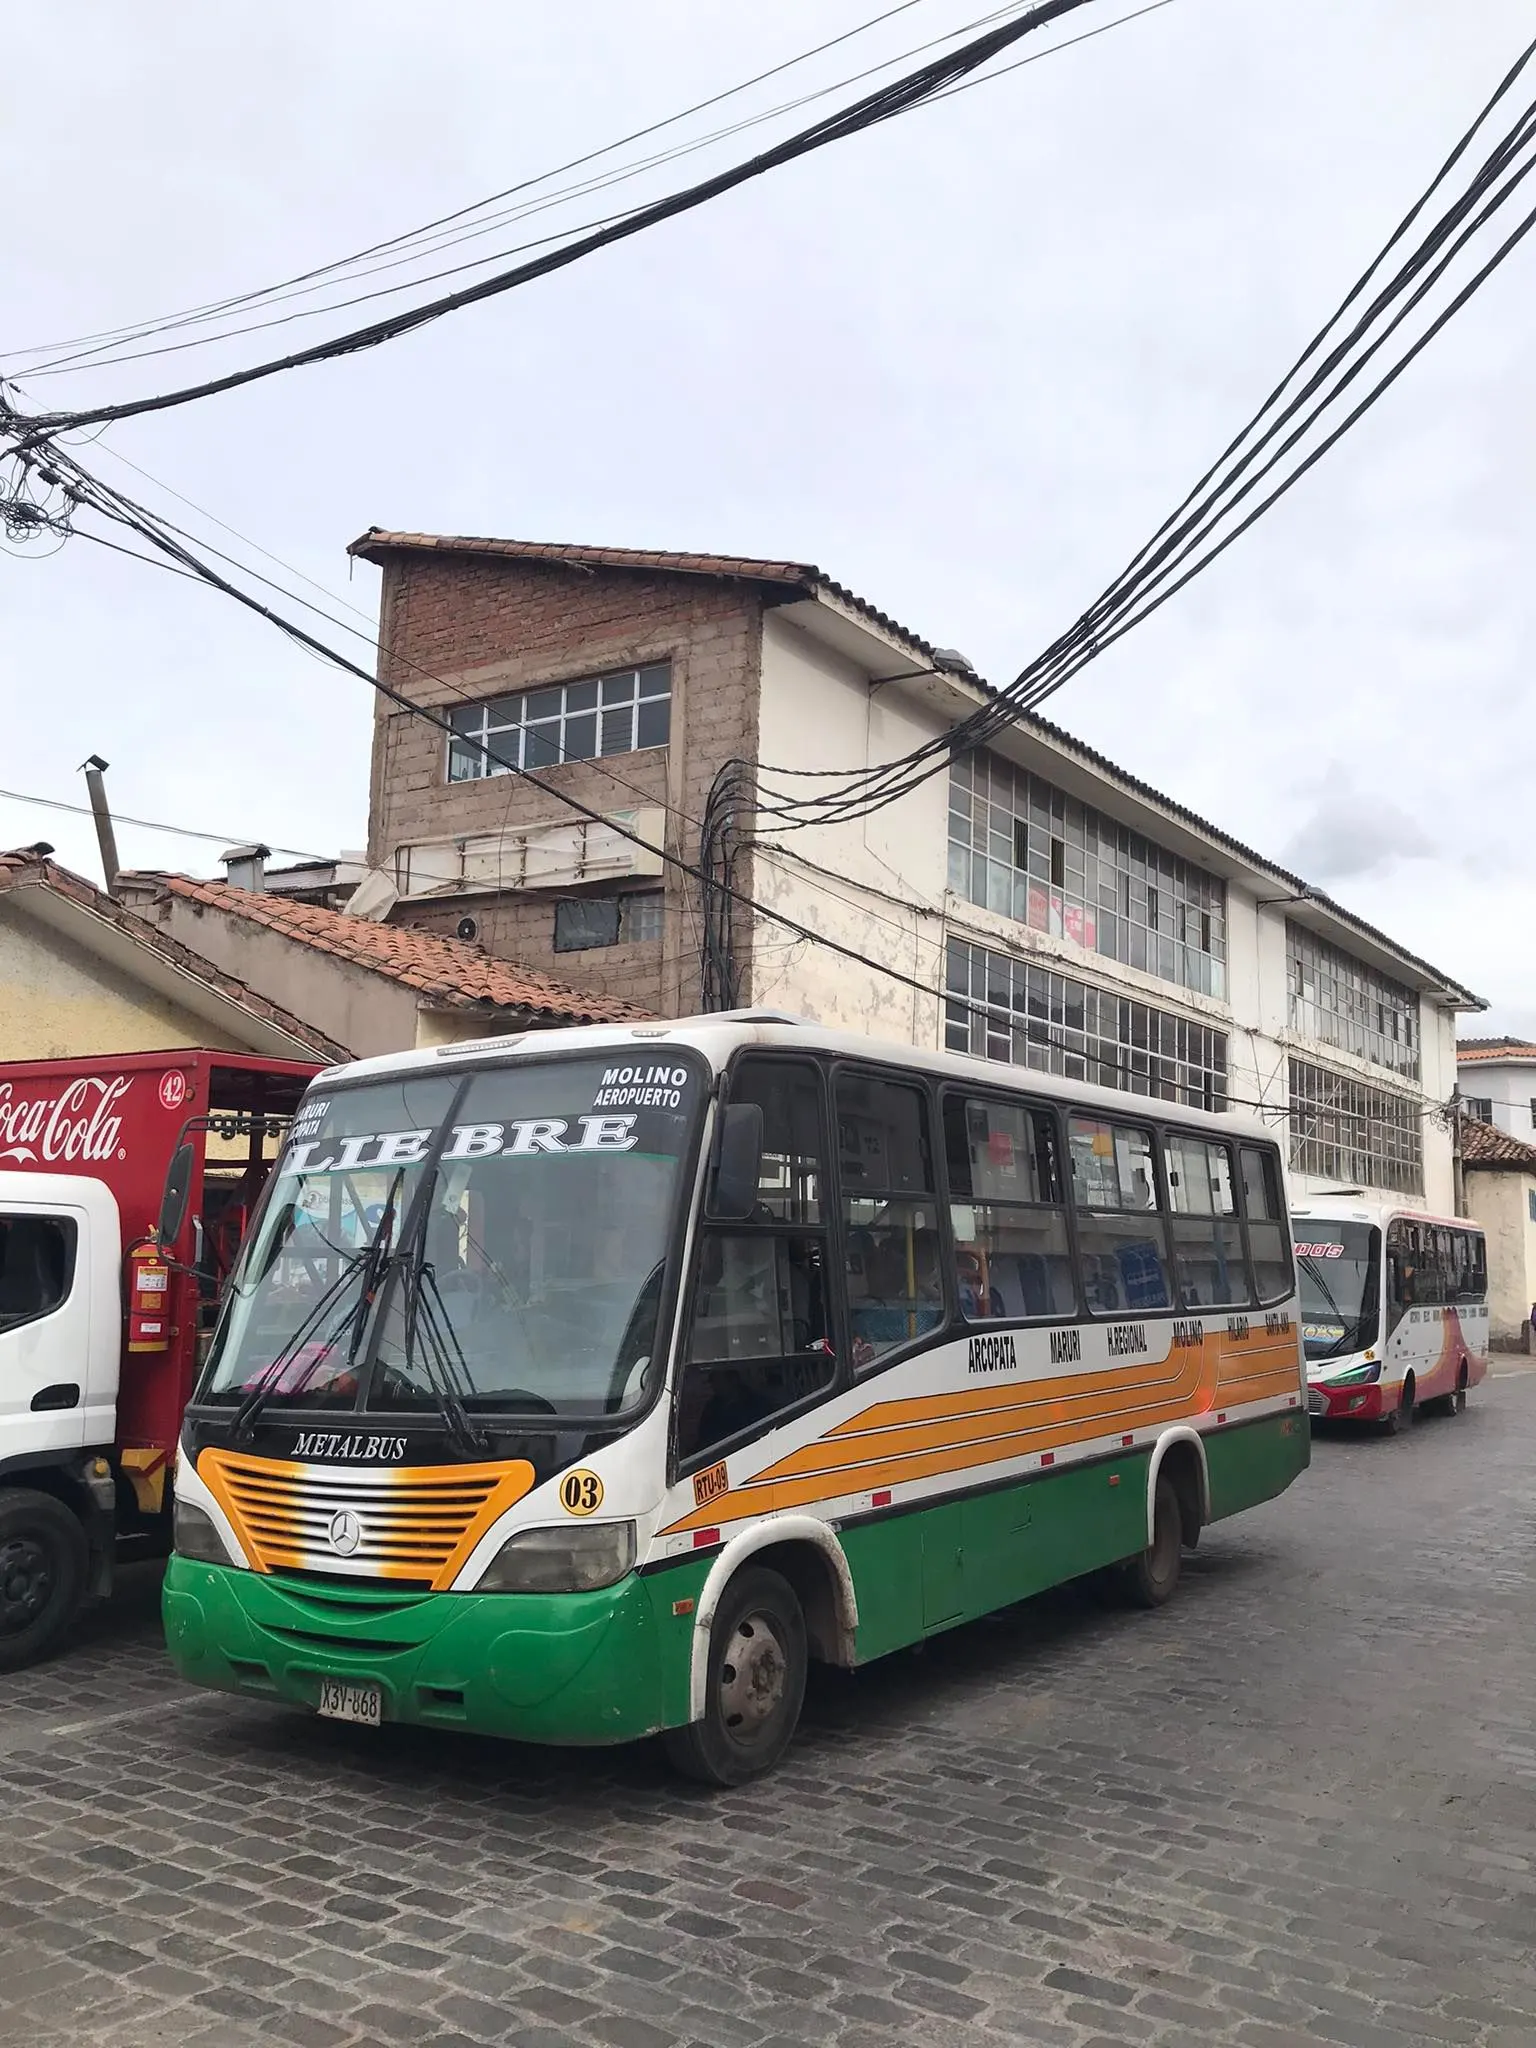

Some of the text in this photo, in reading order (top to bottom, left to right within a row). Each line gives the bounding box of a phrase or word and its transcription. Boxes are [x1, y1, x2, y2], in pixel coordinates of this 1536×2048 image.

[162, 1075, 183, 1103] 42
[601, 1066, 688, 1087] MOLINO
[593, 1087, 681, 1109] AEROPUERTO
[968, 1335, 1017, 1374] ARCOPATA
[1049, 1329, 1082, 1364] MARURI
[1106, 1324, 1148, 1357] H.REGIONAL
[1172, 1319, 1204, 1348] MOLINO
[290, 1432, 408, 1461] METALBUS
[565, 1476, 598, 1509] 03
[695, 1465, 727, 1502] RTU-09
